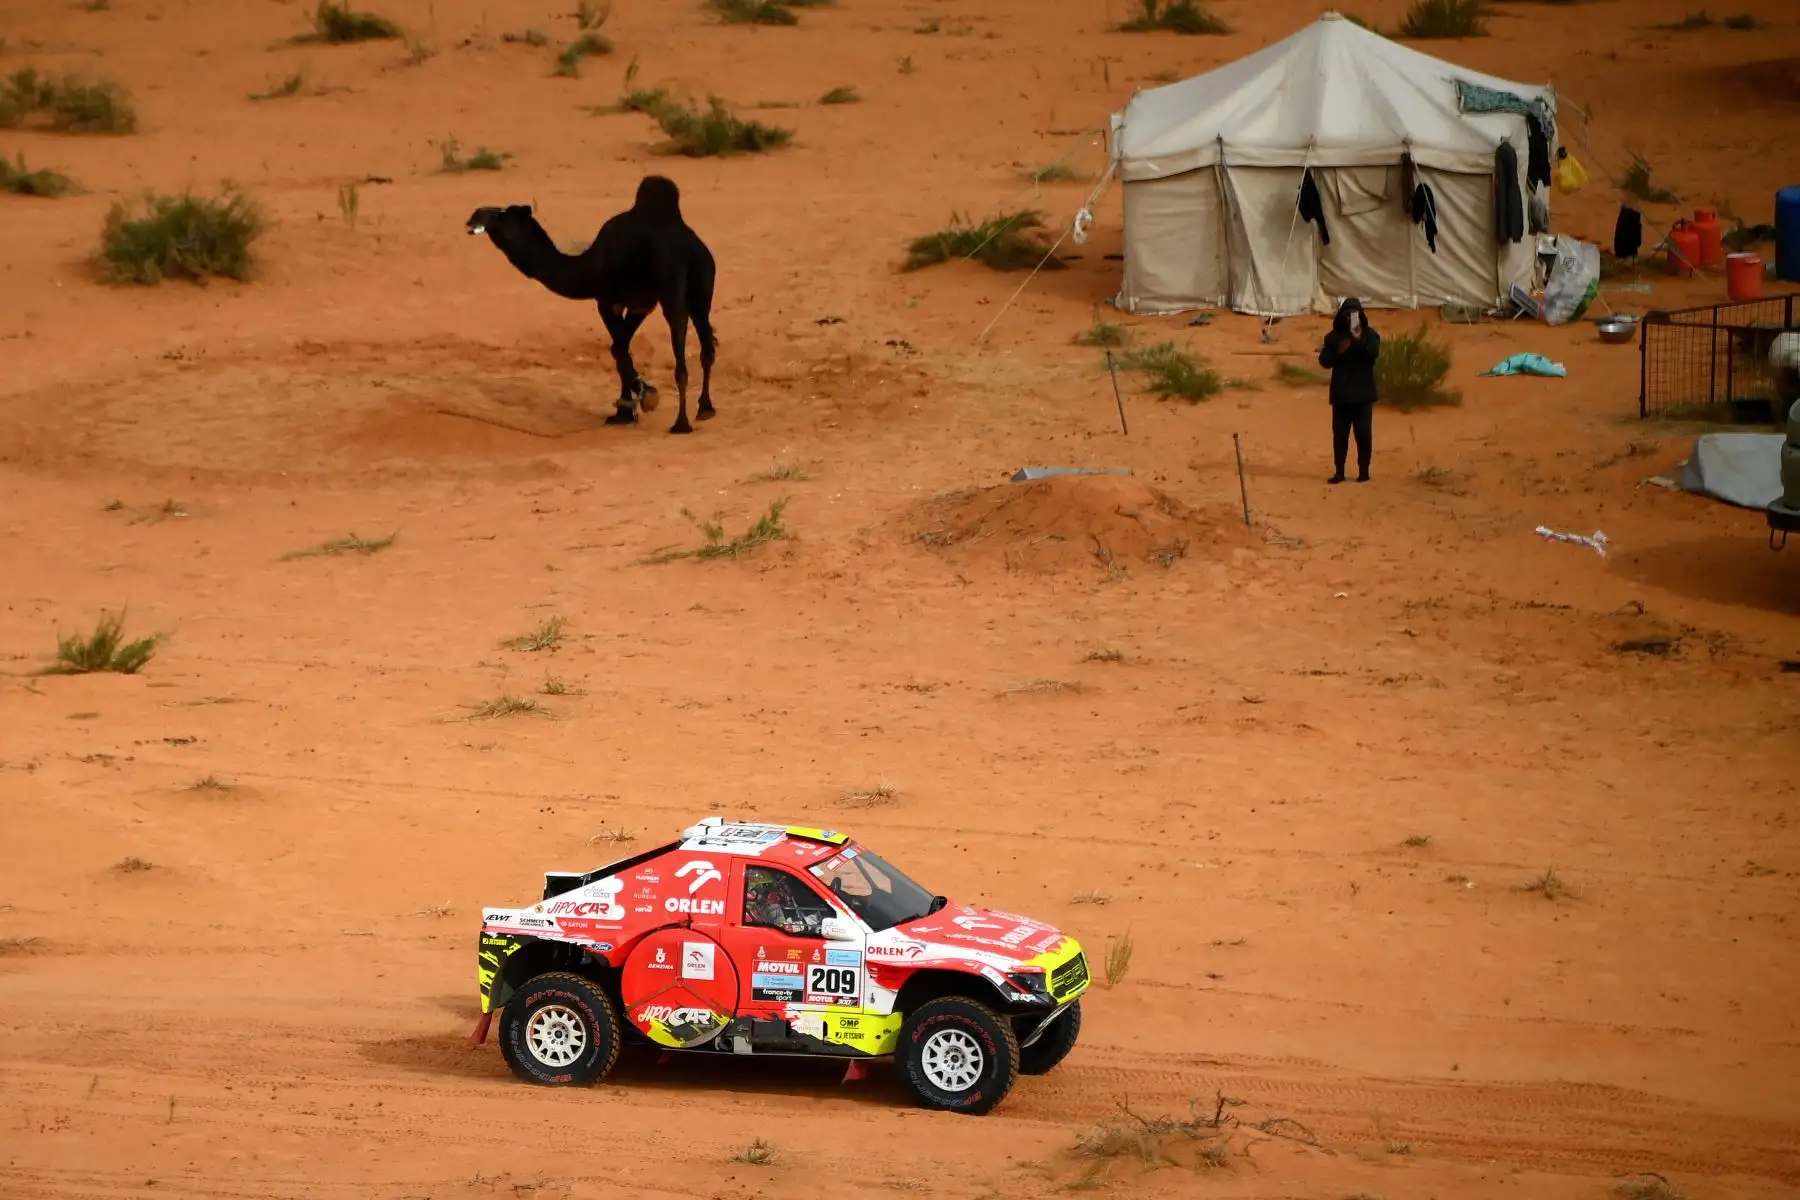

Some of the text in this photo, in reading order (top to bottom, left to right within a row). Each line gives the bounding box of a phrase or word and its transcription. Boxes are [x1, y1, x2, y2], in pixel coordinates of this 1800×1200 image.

[665, 897, 724, 914] ORLEN
[867, 946, 904, 956] ORLEN
[757, 962, 800, 974] MOTUL
[811, 968, 856, 995] 209
[808, 995, 833, 1003] MOTUL
[840, 1019, 860, 1028] OMP
